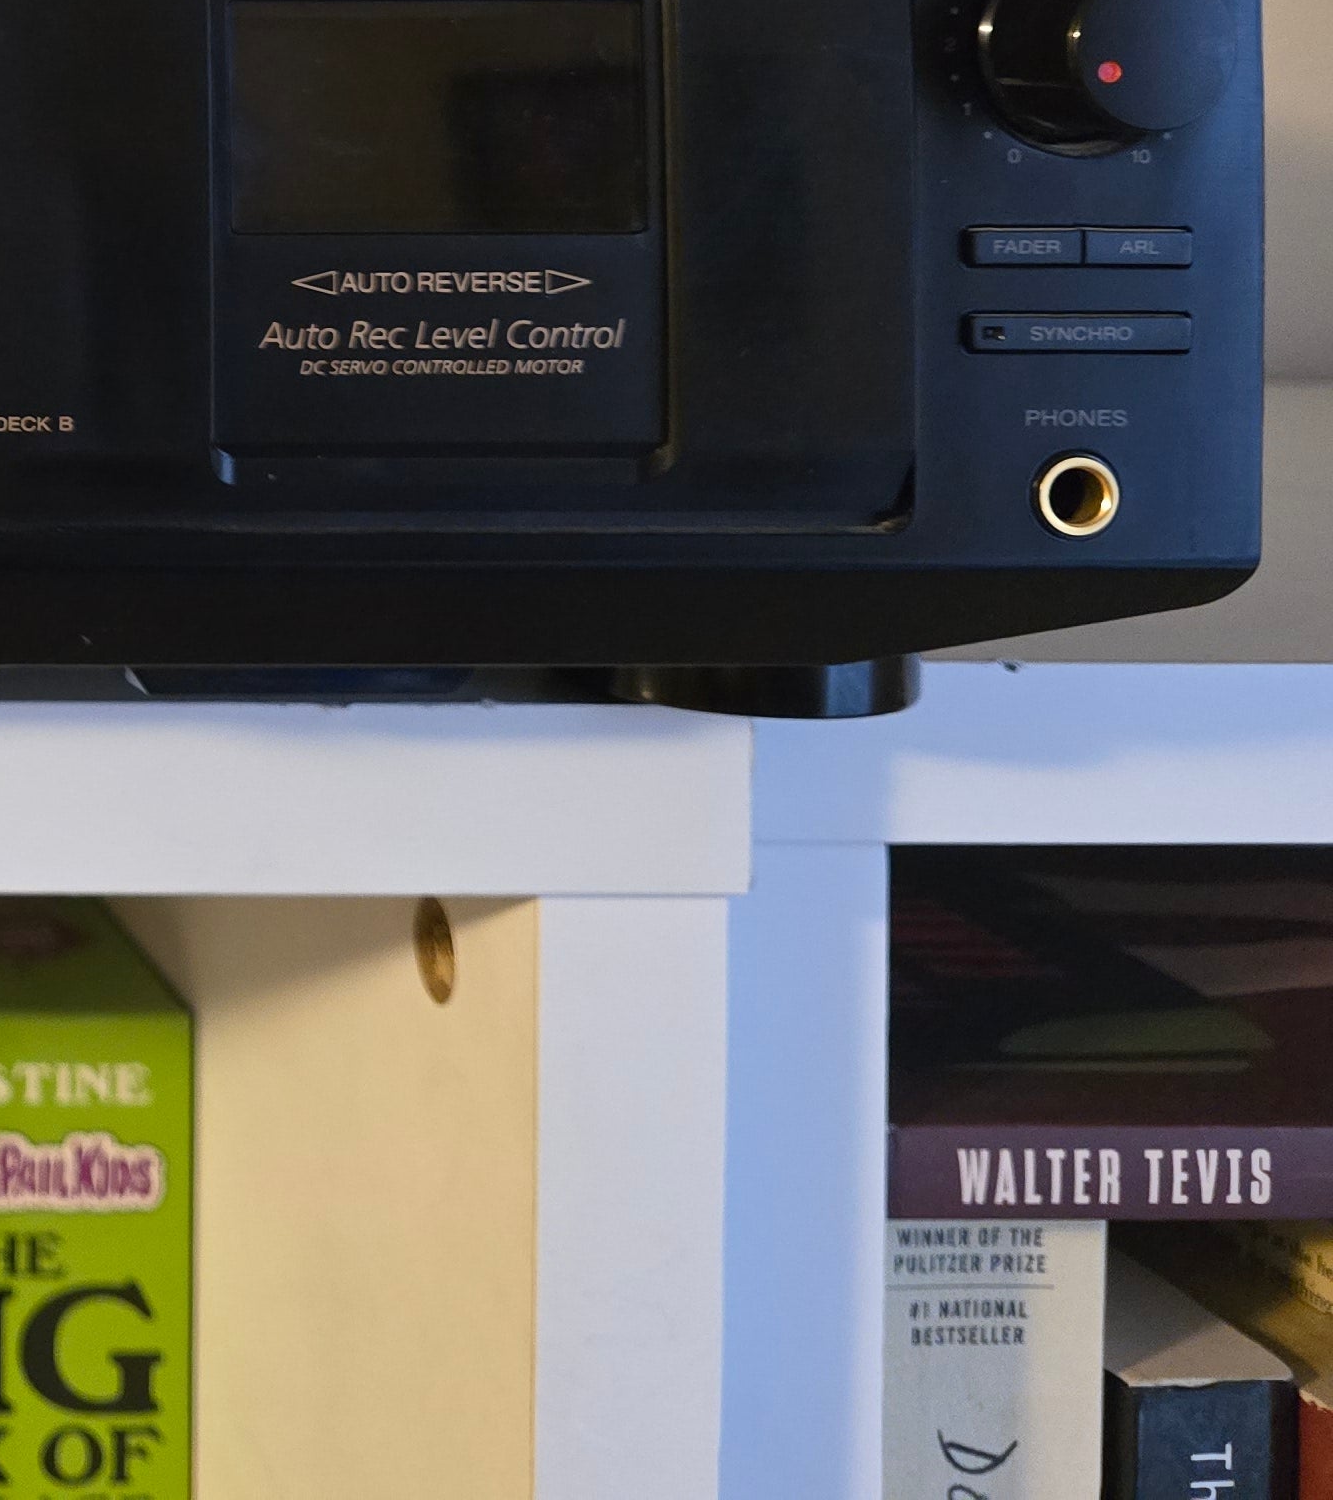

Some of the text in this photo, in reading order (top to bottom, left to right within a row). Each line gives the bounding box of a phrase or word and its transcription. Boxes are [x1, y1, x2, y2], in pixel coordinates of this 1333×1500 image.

[1132, 149, 1151, 164] 10
[992, 239, 1062, 255] FADER
[1119, 240, 1160, 255] ARL
[339, 271, 545, 294] AUTO REVERSE
[258, 318, 626, 350] Auto Rec Level Control
[1029, 326, 1134, 342] SYNCHRO
[299, 359, 586, 376] DC SERVO CONTROLLED MOTOR
[58, 415, 75, 432] B
[1024, 409, 1129, 428] PHONES
[957, 1148, 1272, 1205] WALTER TEVIS
[896, 1226, 1045, 1247] WINNER OF THE
[893, 1253, 1047, 1274] PULITZER PRIZE
[938, 1299, 1029, 1320] NATIONAL
[910, 1325, 1025, 1346] BESTSELLER
[39, 1423, 165, 1488] OF
